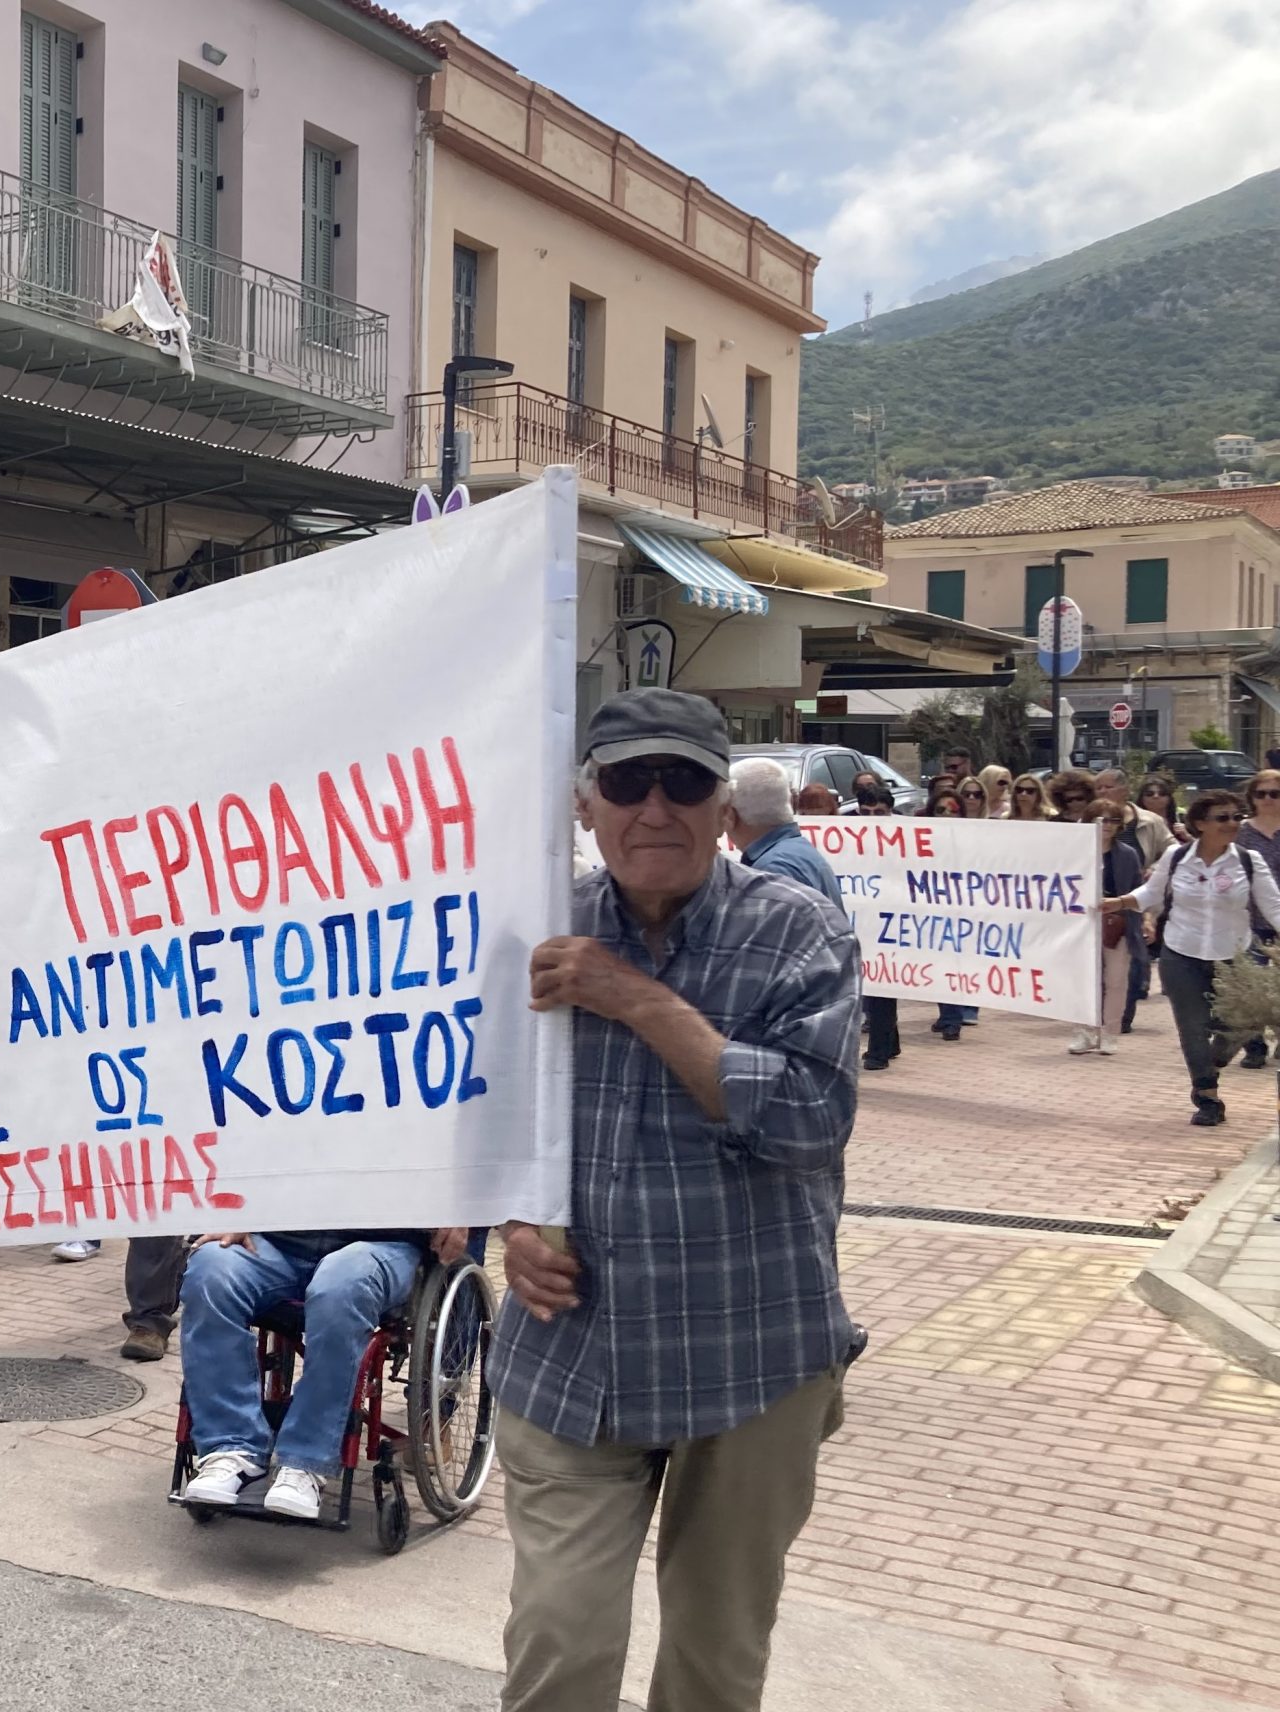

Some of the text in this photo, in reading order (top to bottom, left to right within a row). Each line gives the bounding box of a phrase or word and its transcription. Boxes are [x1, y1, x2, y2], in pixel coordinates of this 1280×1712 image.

[41, 736, 476, 943] ΠΕΡΙΘΑΛΨΗ
[907, 870, 1086, 914] ΜΗΤΡΟΤΗΤΑΣ
[9, 892, 480, 1044] ΑΝΤΙΜΕΤΩΠΙΖΕΙ
[878, 912, 1024, 959] ΖΕΥΓΑΡΙΩΝ
[89, 1046, 164, 1131] ΩΣ
[201, 996, 487, 1127] ΚΟΣΤΟΣ
